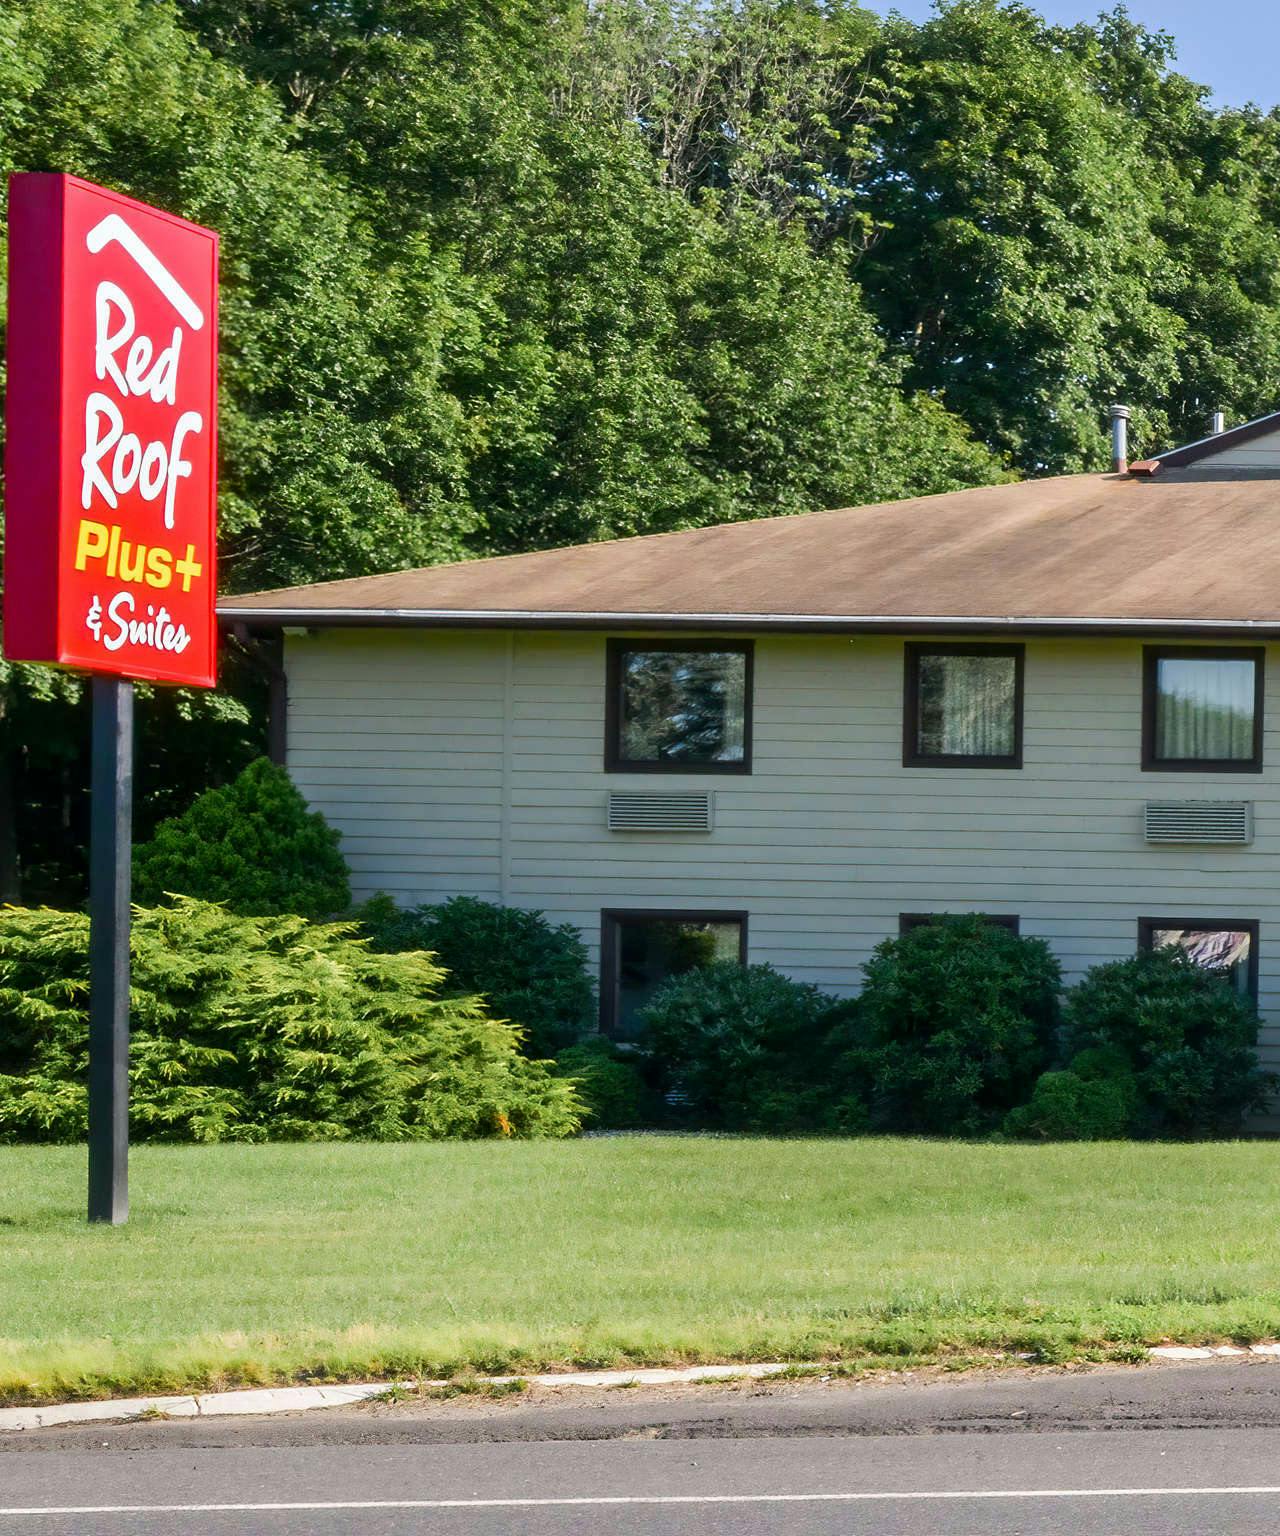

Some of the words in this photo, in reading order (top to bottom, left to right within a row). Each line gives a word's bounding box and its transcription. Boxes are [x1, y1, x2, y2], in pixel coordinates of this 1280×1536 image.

[94, 280, 184, 406] Red
[80, 391, 204, 530] Roof
[74, 519, 203, 593] Plus+
[103, 591, 191, 654] Suites
